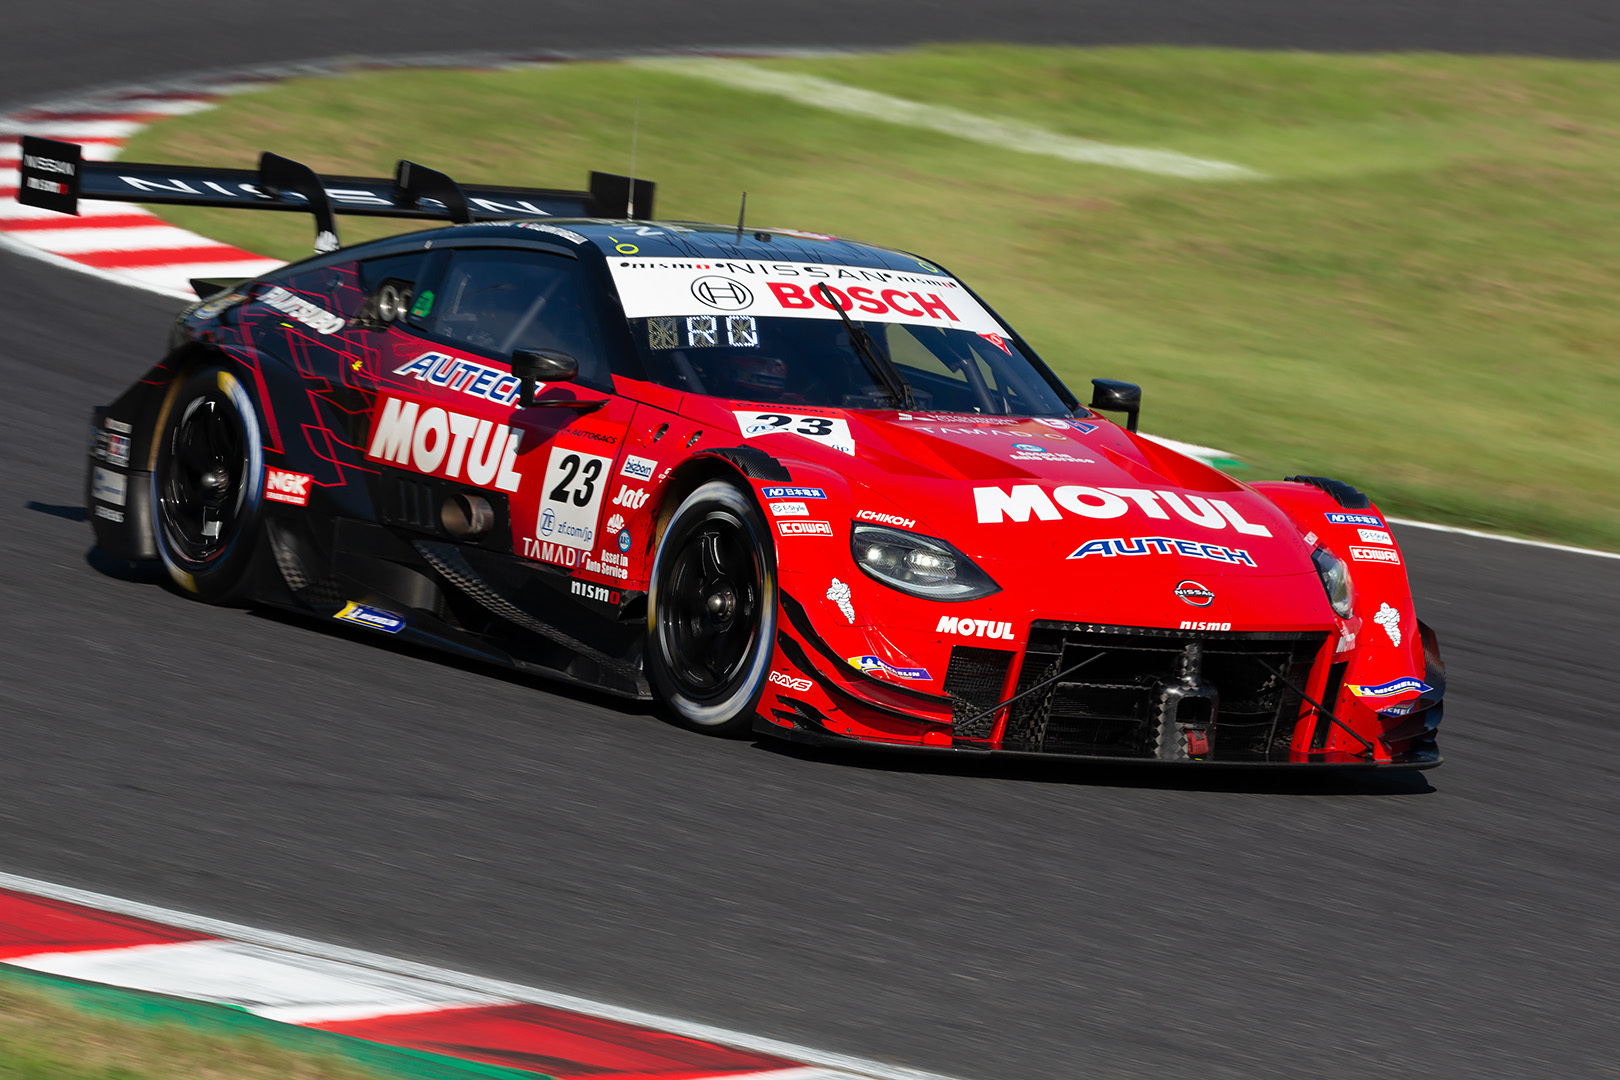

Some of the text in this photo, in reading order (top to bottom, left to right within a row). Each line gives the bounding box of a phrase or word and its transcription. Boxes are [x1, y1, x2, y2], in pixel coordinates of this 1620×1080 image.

[725, 262, 889, 283] NISSAN
[765, 281, 961, 323] BOSCH
[755, 414, 834, 436] 23
[368, 397, 525, 493] MOTUL
[570, 429, 618, 444] AUTOBACS
[267, 470, 310, 496] NGK
[549, 453, 603, 508] 23
[855, 509, 916, 528] ICHIKOH
[972, 484, 1274, 538] MOTUL
[601, 549, 629, 567] Asset in
[1065, 536, 1258, 568] AUTECH
[585, 558, 628, 580] Auto Service
[571, 580, 621, 605] nismo
[1173, 588, 1215, 598] NISSAN
[935, 615, 1015, 640] MOTUL
[1180, 620, 1232, 632] nismo
[769, 670, 813, 692] RAYS
[1374, 680, 1422, 695] MICHELIN
